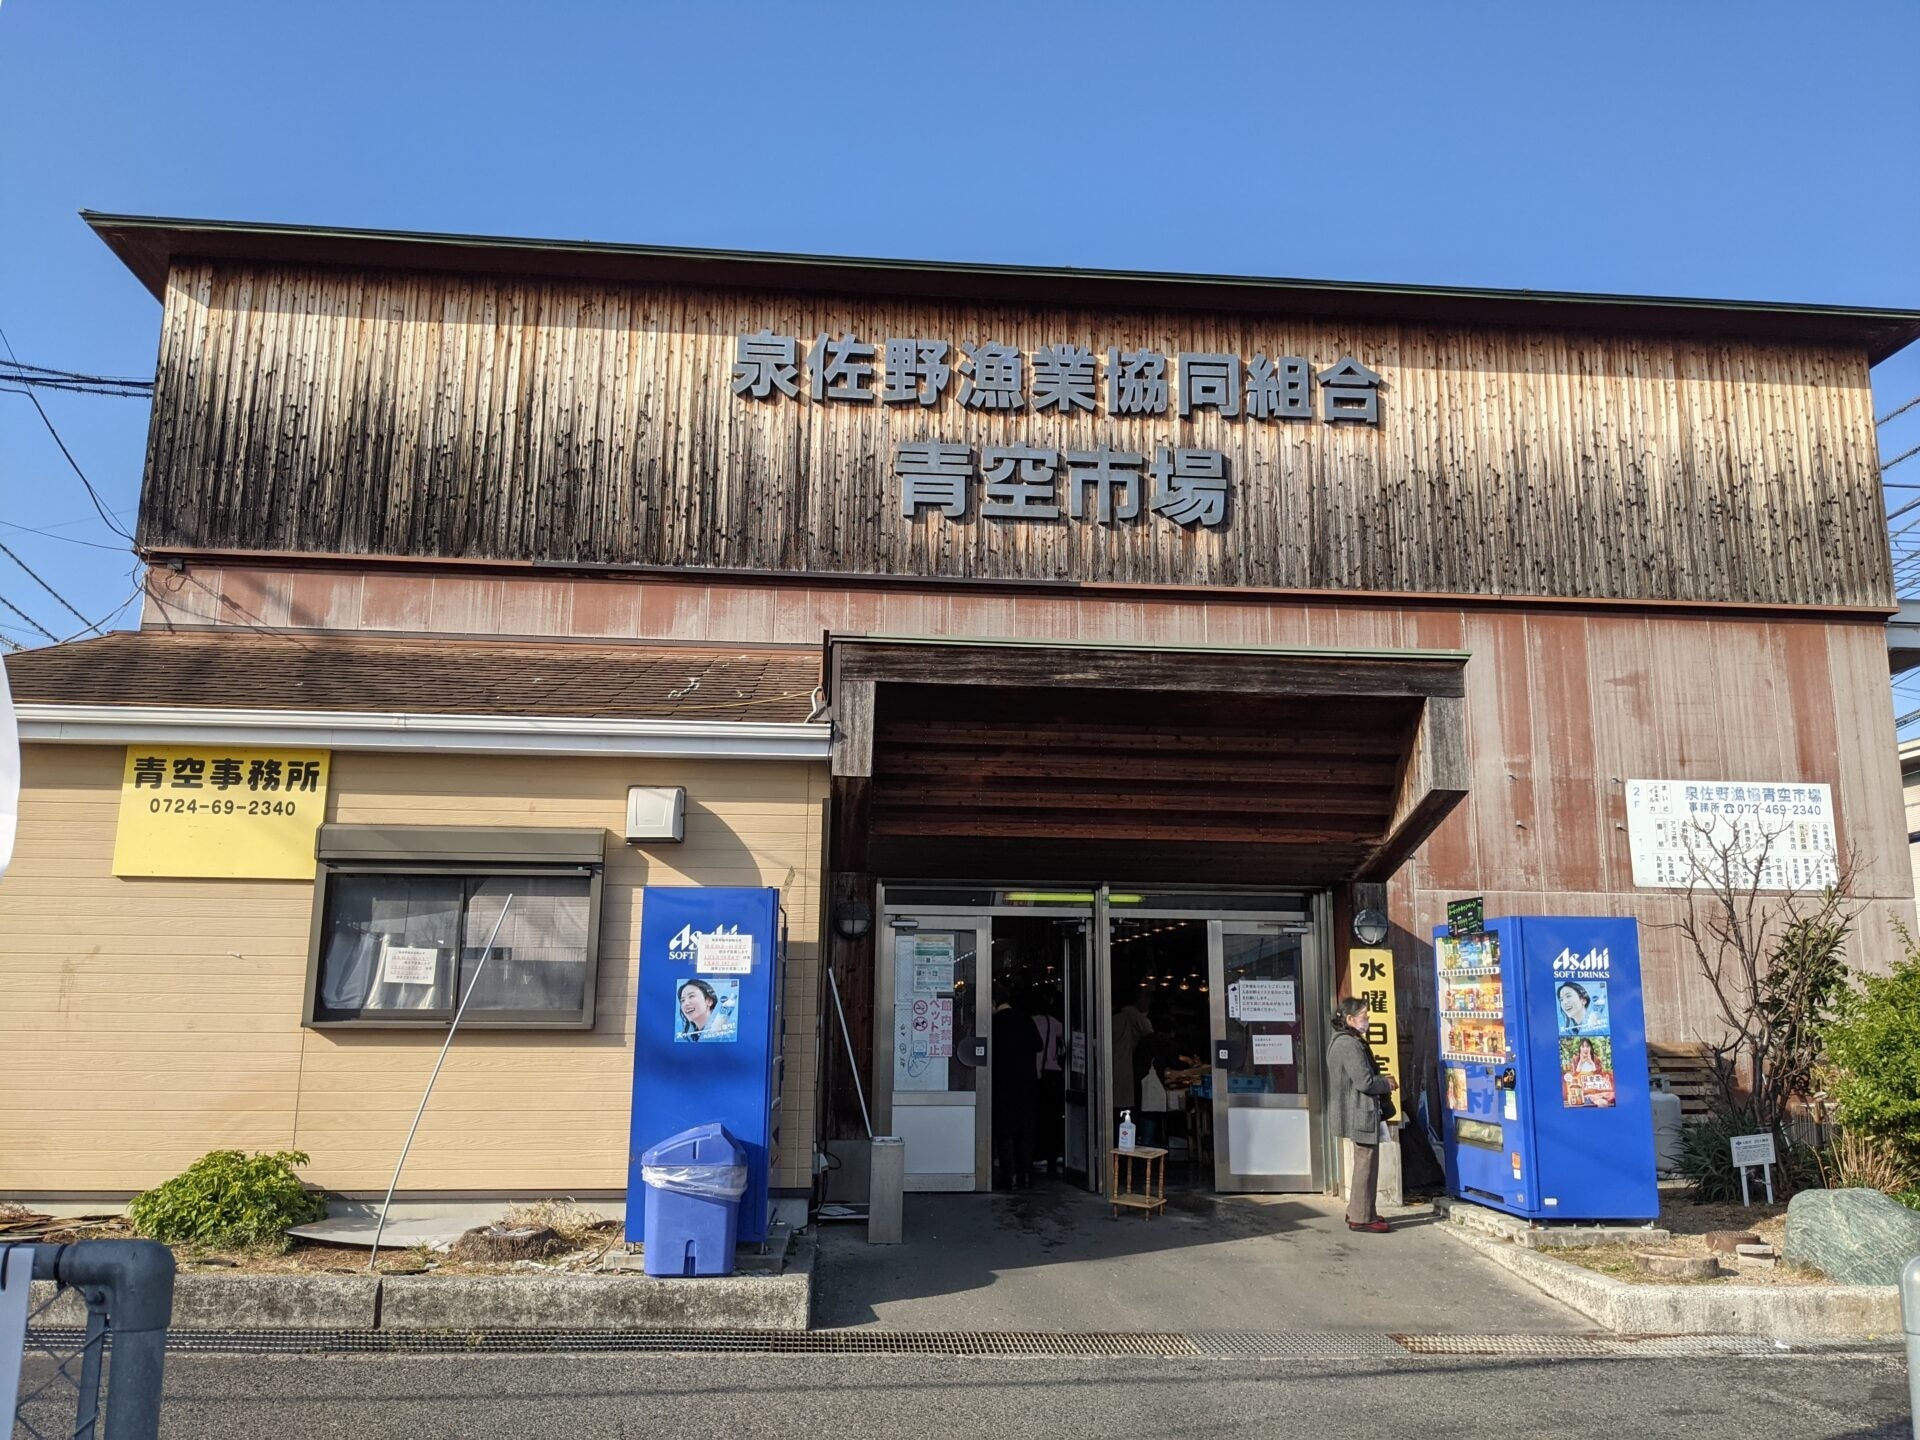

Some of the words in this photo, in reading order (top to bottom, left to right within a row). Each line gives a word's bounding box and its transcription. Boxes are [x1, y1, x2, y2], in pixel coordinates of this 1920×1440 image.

[731, 330, 1385, 424] 泉佐野漁業協同組合
[895, 440, 1229, 526] 青空市場
[134, 757, 320, 793] 青空事務所
[1685, 786, 1822, 803] 泉佐野漁協青空市場
[150, 798, 296, 816] 0724-69-2340
[1689, 802, 1720, 813] 事務所
[1738, 803, 1822, 815] 072-469-2340
[669, 951, 695, 960] SOFT
[1553, 947, 1610, 970] Asahi
[1553, 971, 1576, 979] SOFT
[1577, 971, 1610, 979] DRINKS
